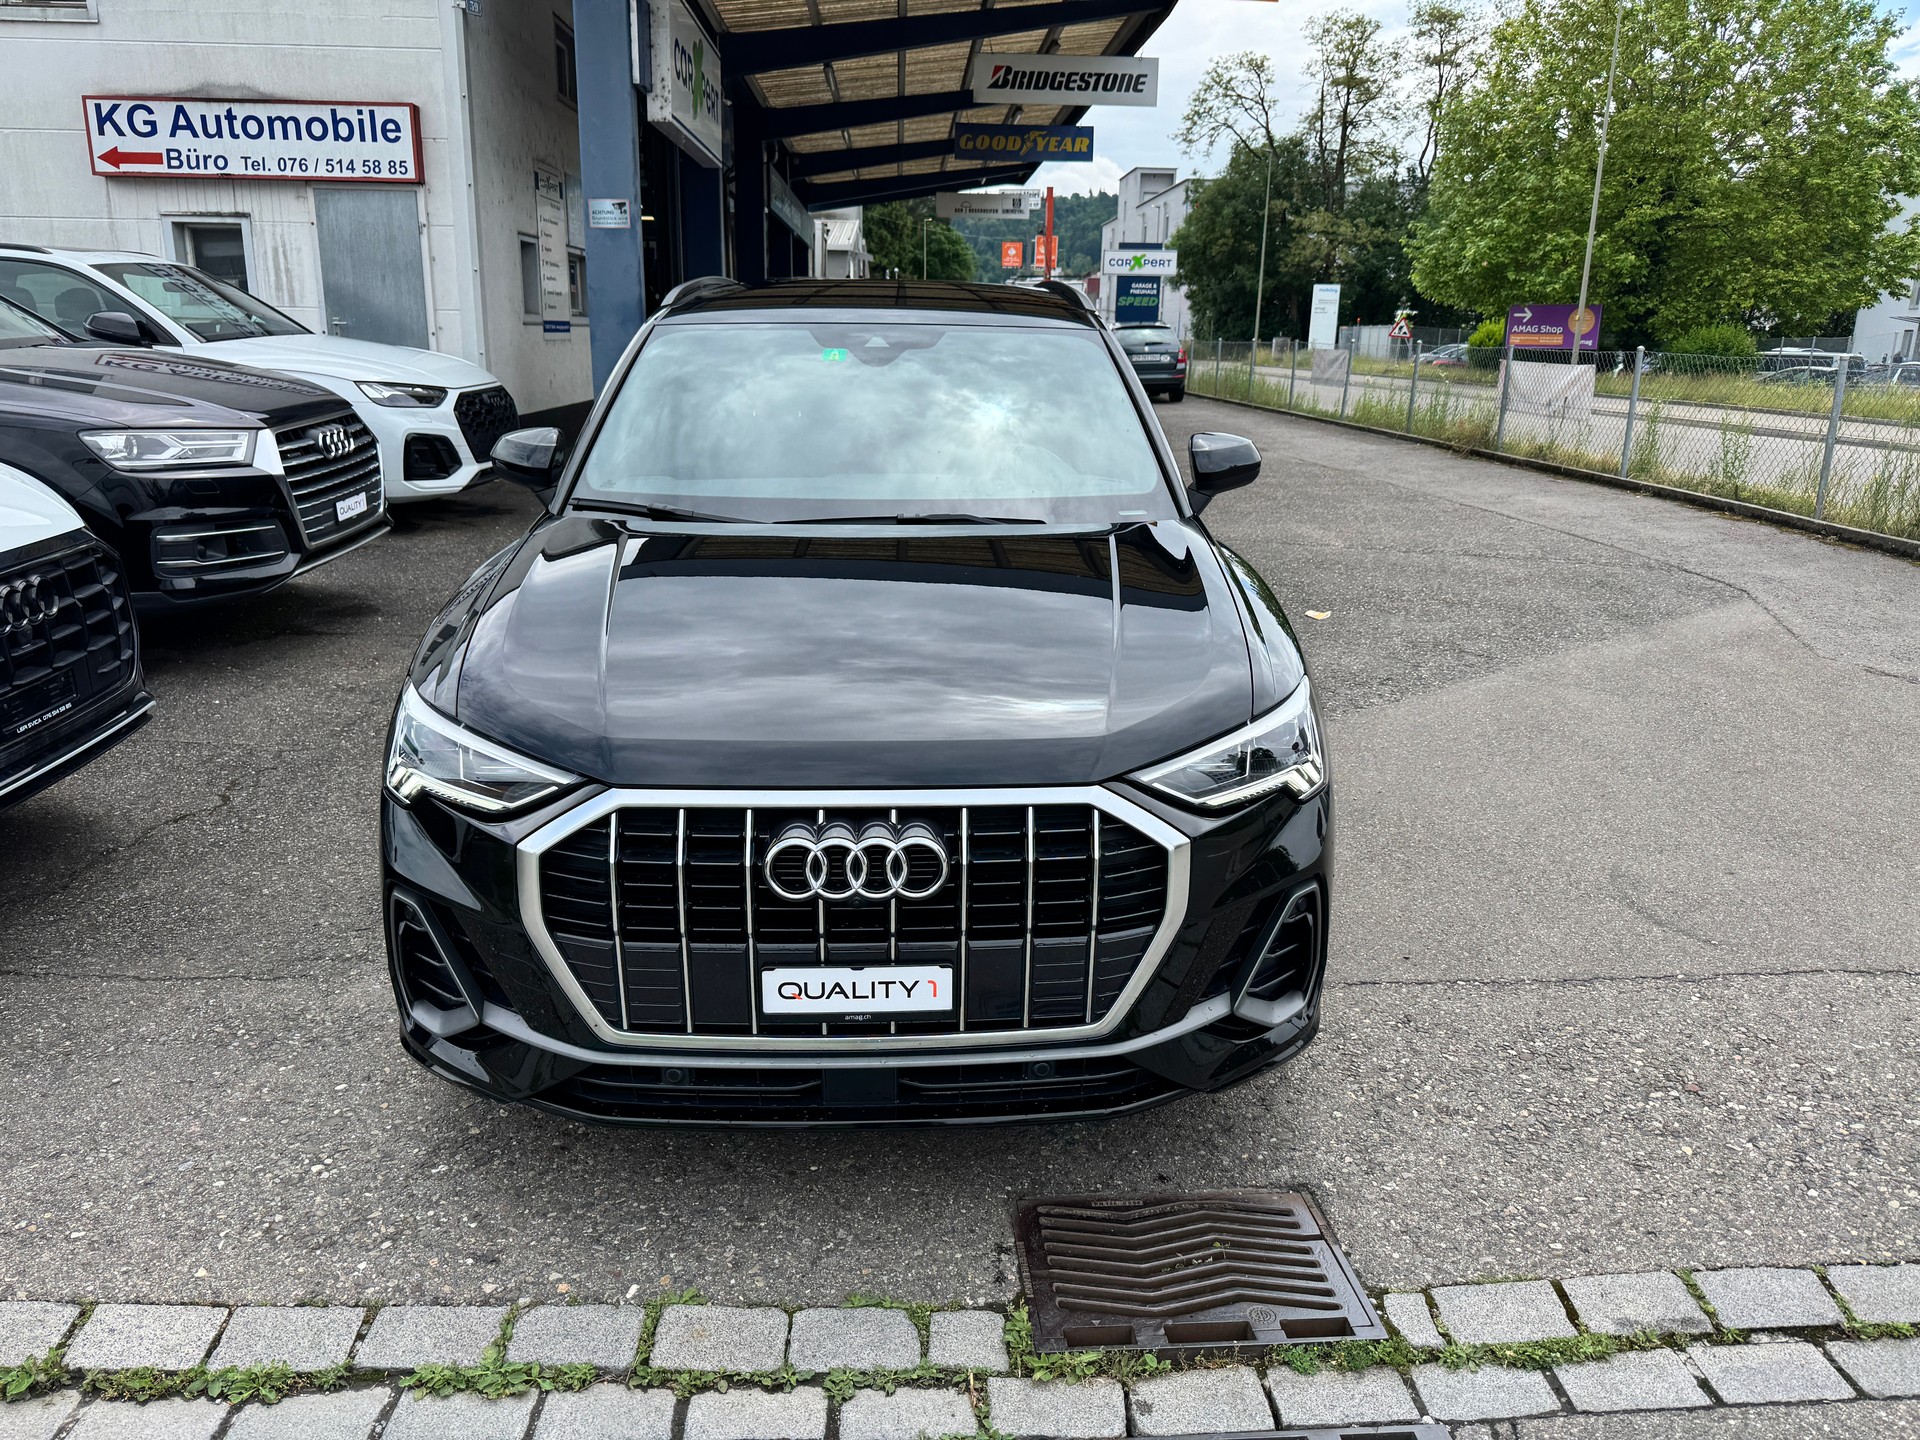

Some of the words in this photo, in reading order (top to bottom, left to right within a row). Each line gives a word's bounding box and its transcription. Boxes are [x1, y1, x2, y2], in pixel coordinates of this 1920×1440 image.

[987, 65, 1148, 93] BRIDGESTONE
[94, 103, 159, 138] KG
[169, 104, 402, 143] Automobile
[165, 148, 229, 171] Büro
[240, 156, 271, 172] Tel.
[277, 157, 308, 173] 076
[314, 158, 319, 173] /
[325, 158, 355, 174] 514
[362, 159, 382, 175] 58
[388, 160, 408, 175] 85
[1118, 296, 1158, 306] SPEED
[1511, 325, 1538, 333] AMAG
[1540, 325, 1563, 334] Shop
[340, 500, 361, 515] QUALITY
[778, 980, 920, 1000] QUALITY
[927, 980, 937, 998] 1
